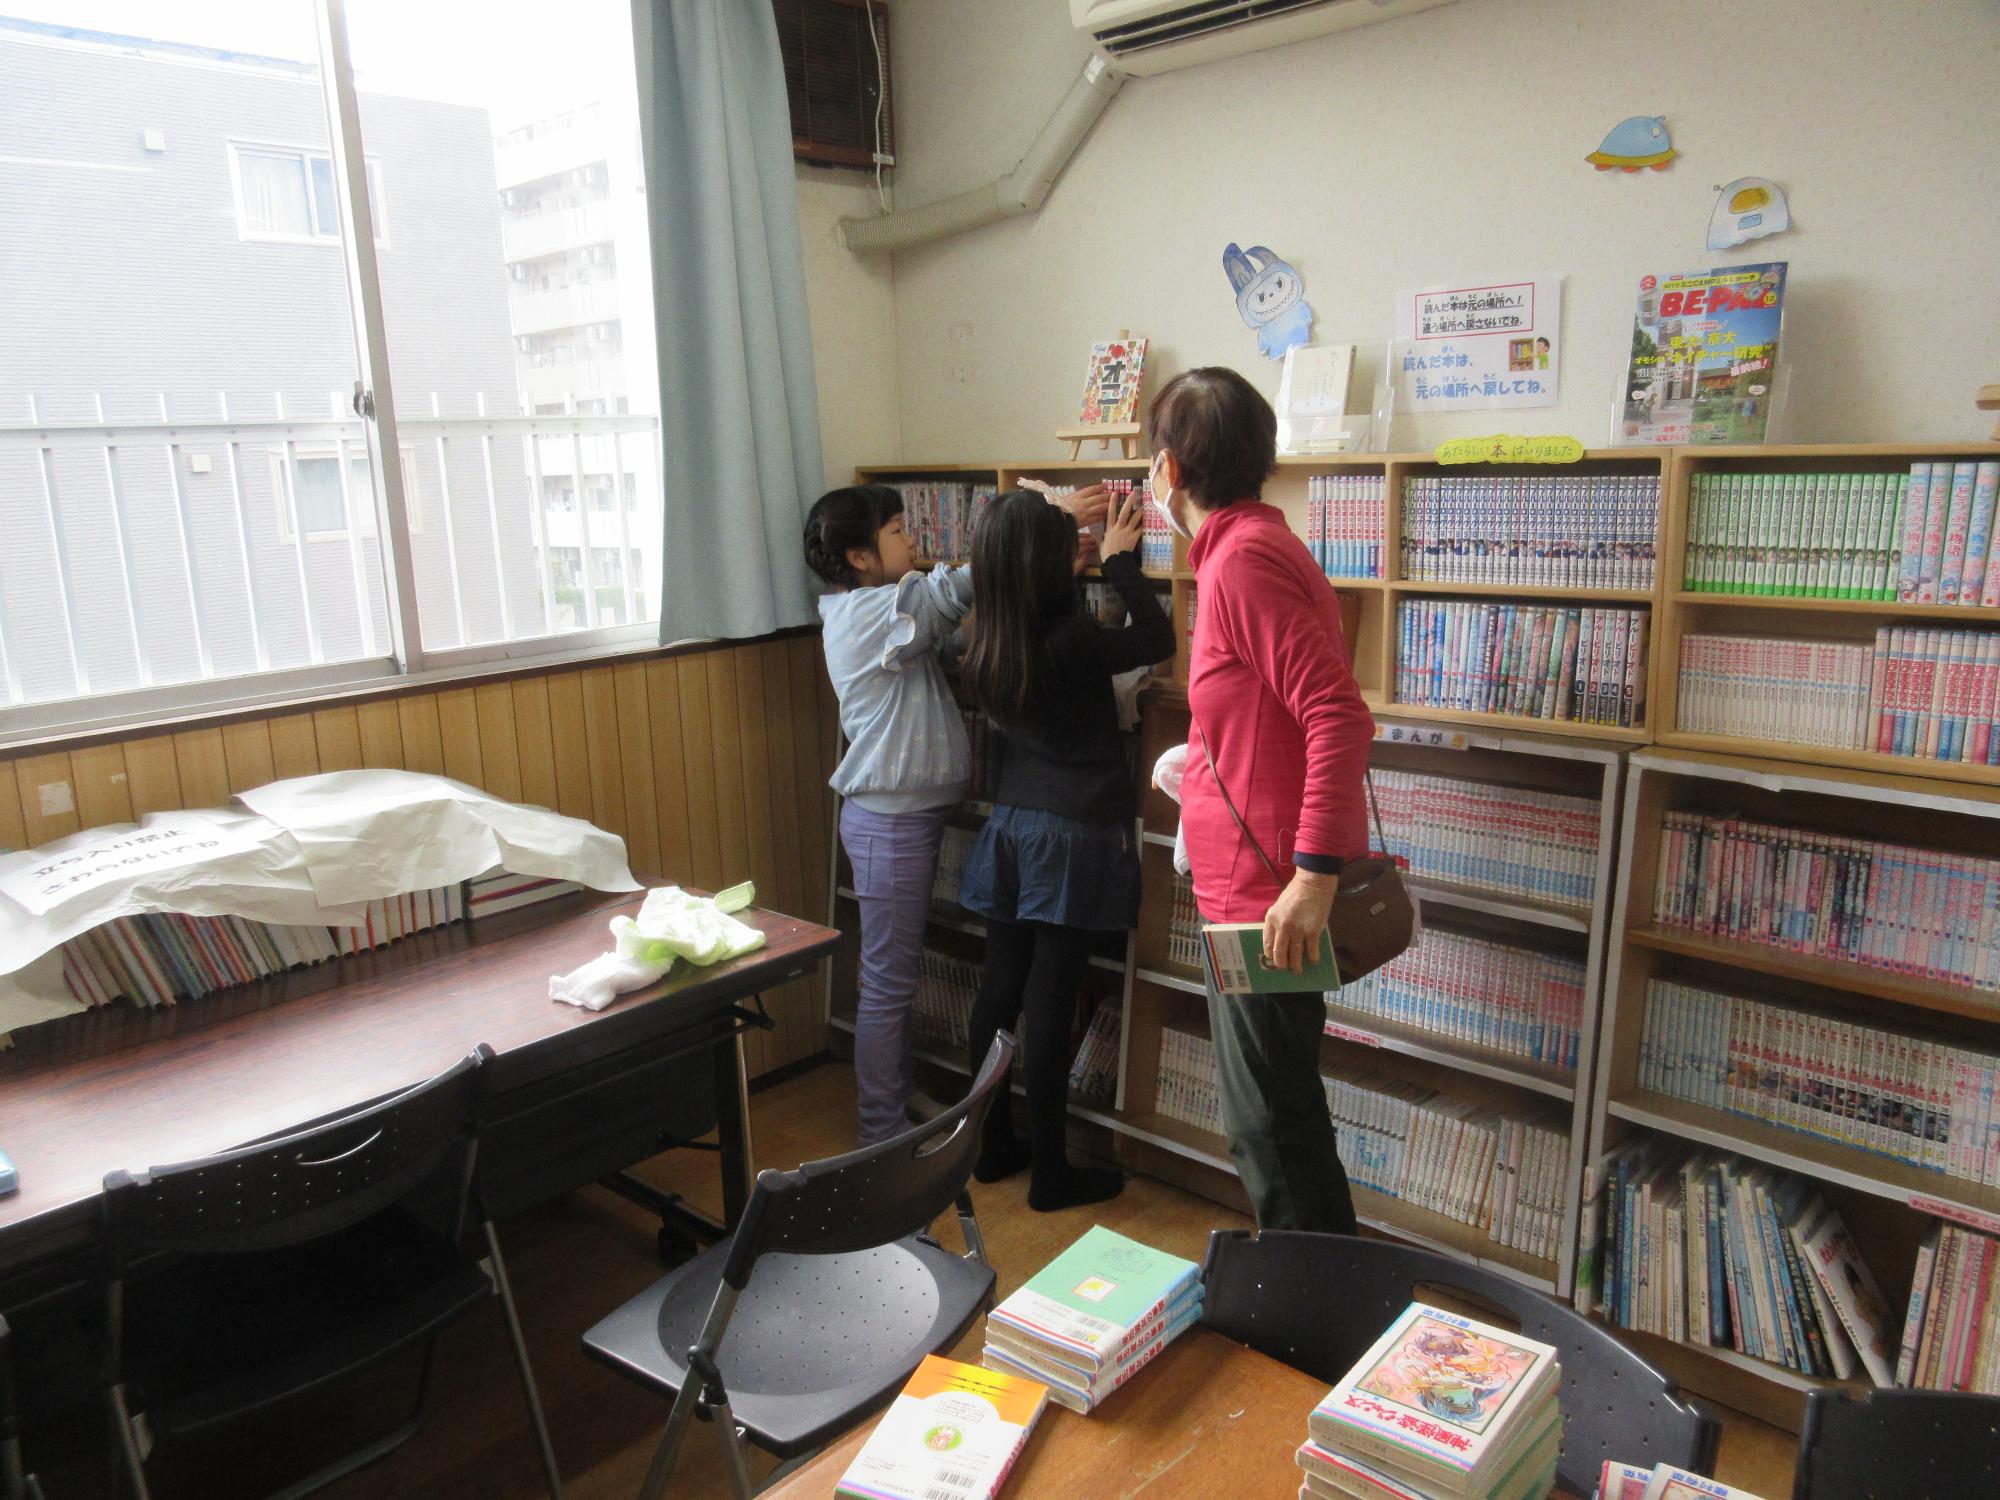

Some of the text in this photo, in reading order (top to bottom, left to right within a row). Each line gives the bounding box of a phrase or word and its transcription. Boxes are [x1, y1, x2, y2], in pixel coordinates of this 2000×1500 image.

[1392, 728, 1442, 745] まんが
[1344, 1394, 1473, 1452] 神風怪盗ジャンヌ
